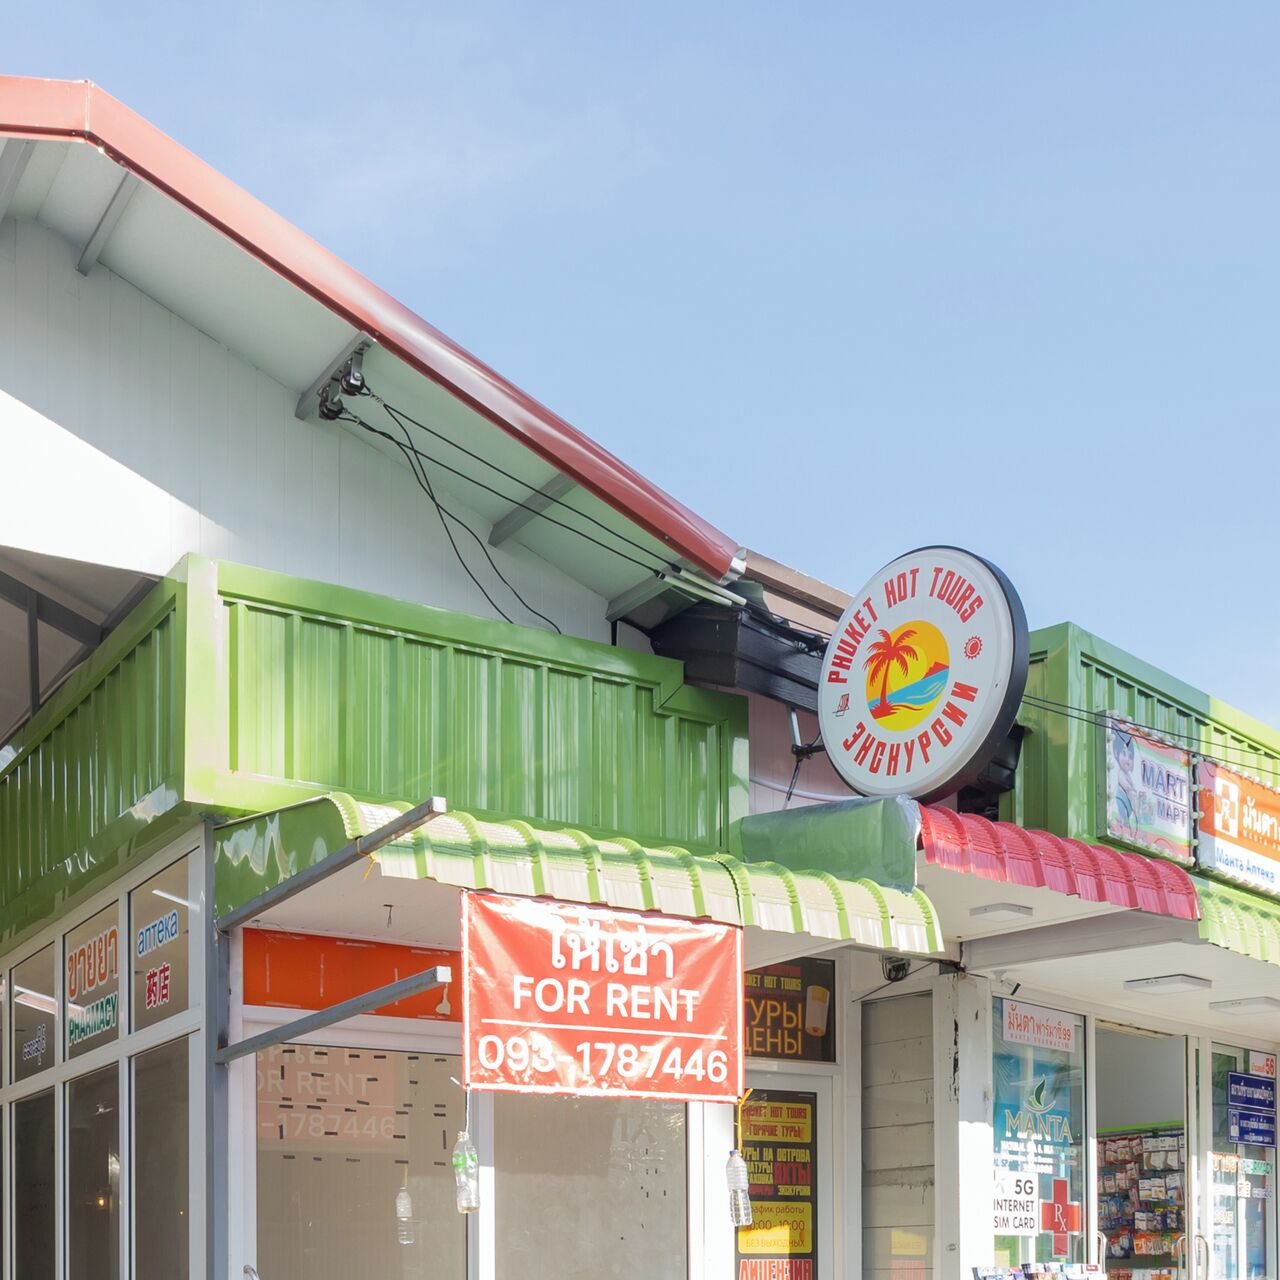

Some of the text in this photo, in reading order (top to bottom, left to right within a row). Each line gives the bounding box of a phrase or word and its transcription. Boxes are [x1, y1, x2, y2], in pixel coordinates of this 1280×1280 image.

[827, 566, 984, 685] PHUKET HOT TOURS
[1141, 759, 1187, 801] MART
[138, 910, 179, 957] аптека
[550, 914, 675, 979] ให้เช่า
[67, 926, 119, 999] ขายยา
[146, 963, 171, 1010] 药店
[513, 976, 700, 1023] FOR RENT
[68, 993, 118, 1045] PHARMACY
[476, 1034, 729, 1084] 093-1787446
[1005, 1109, 1074, 1144] MANTA
[742, 1147, 760, 1161] УРЫ
[775, 1205, 805, 1216] работы
[993, 1198, 1035, 1213] INTERNET
[1014, 1178, 1034, 1196] 5G
[993, 1215, 1036, 1230] SIM CARD
